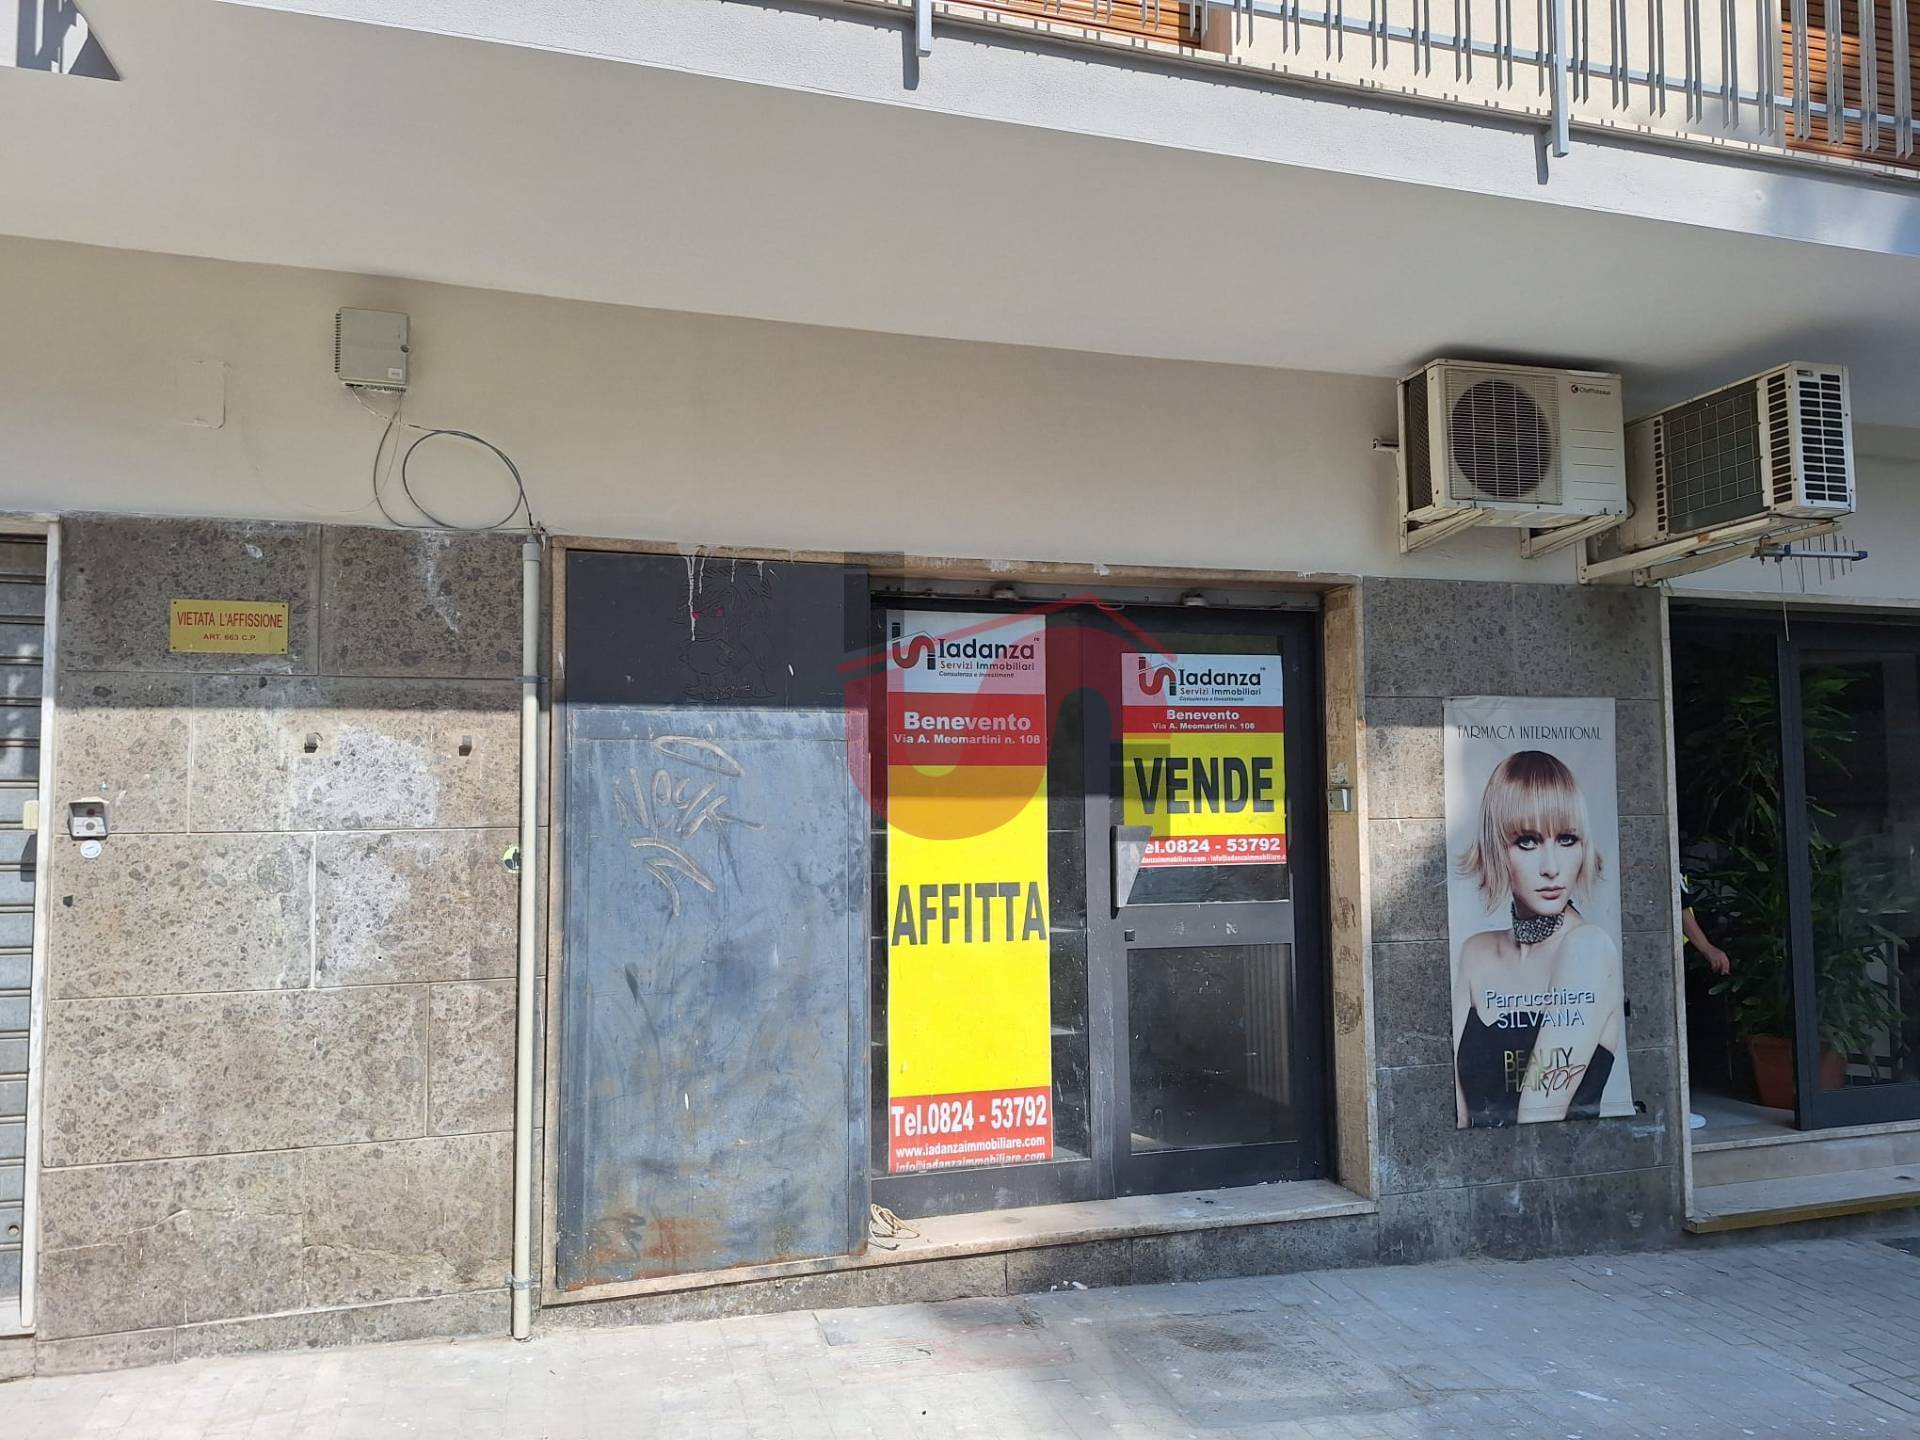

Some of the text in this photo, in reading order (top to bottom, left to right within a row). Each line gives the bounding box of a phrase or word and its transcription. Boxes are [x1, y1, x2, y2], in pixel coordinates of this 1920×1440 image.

[177, 611, 283, 628] VIETATA L'AFFISSIONE
[937, 638, 1034, 660] Iadanza
[940, 660, 1035, 671] Servizi Immobiliari
[1178, 668, 1261, 686] Iadanza
[1180, 687, 1262, 696] Servizi Immobiliari
[903, 711, 1031, 731] Benevento
[1166, 709, 1240, 720] Benevento
[1152, 722, 1166, 730] Via
[1169, 722, 1178, 730] A.
[1179, 722, 1228, 730] Meomartini
[1240, 722, 1255, 730] 108
[1457, 724, 1602, 741] FARMACA INTERNATIONAL
[893, 734, 1041, 744] Via A. Meomartini n. 108
[1133, 757, 1275, 815] VENDE
[1144, 838, 1210, 854] el.0824
[1226, 837, 1281, 853] 53792
[891, 881, 1047, 946] AFFITTA
[1485, 986, 1595, 1009] Parrucchiera
[1497, 1008, 1585, 1029] SILVANA
[1504, 1046, 1573, 1073] BEAUTY
[890, 1094, 1048, 1137] Tel.0824 - 53792
[896, 1136, 1046, 1158] www.iadanzaimmobiliare.com
